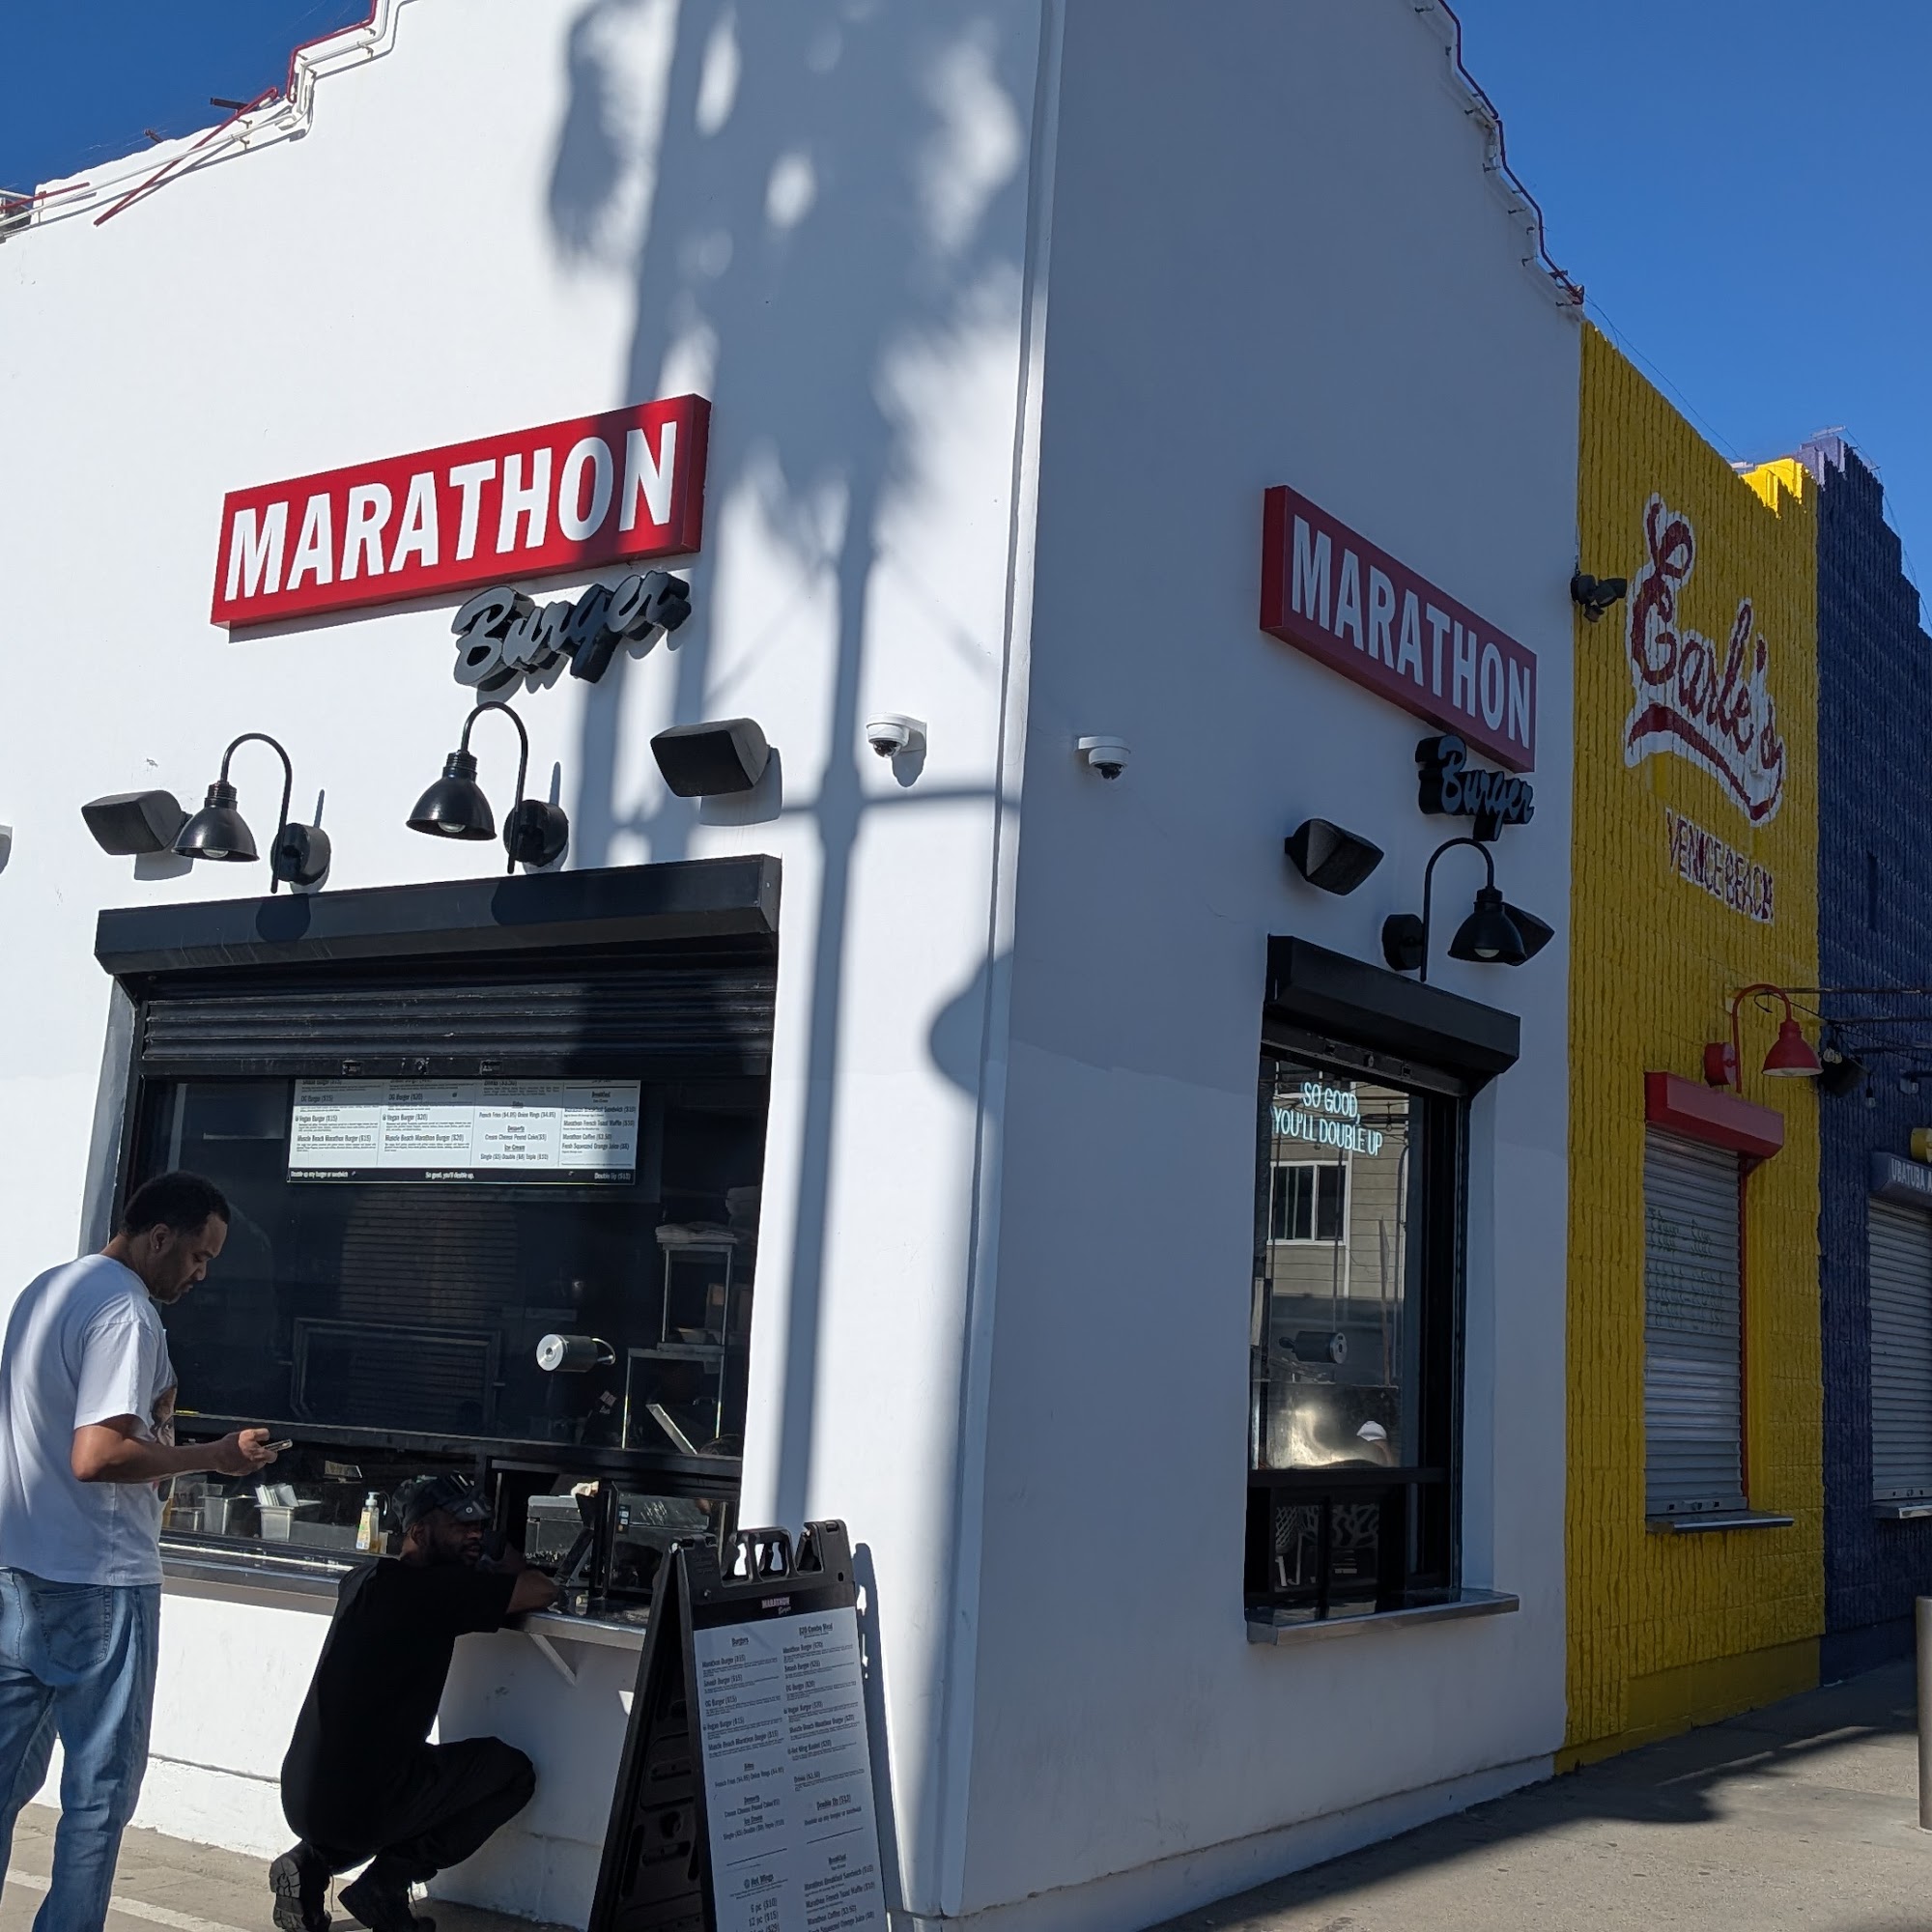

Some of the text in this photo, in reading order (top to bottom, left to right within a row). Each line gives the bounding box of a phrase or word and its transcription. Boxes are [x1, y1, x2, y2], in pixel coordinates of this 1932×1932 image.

[224, 420, 677, 602] MARATHON
[451, 570, 686, 687] Burger
[1292, 514, 1531, 750] MARATHON
[1435, 733, 1535, 840] Burger
[1665, 807, 1775, 924] VENICE BEACH
[1273, 1106, 1383, 1156] YOU'LL DOUBLE UP
[1302, 1081, 1361, 1124] SO GOOD,
[1891, 1157, 1926, 1191] UBATUBA
